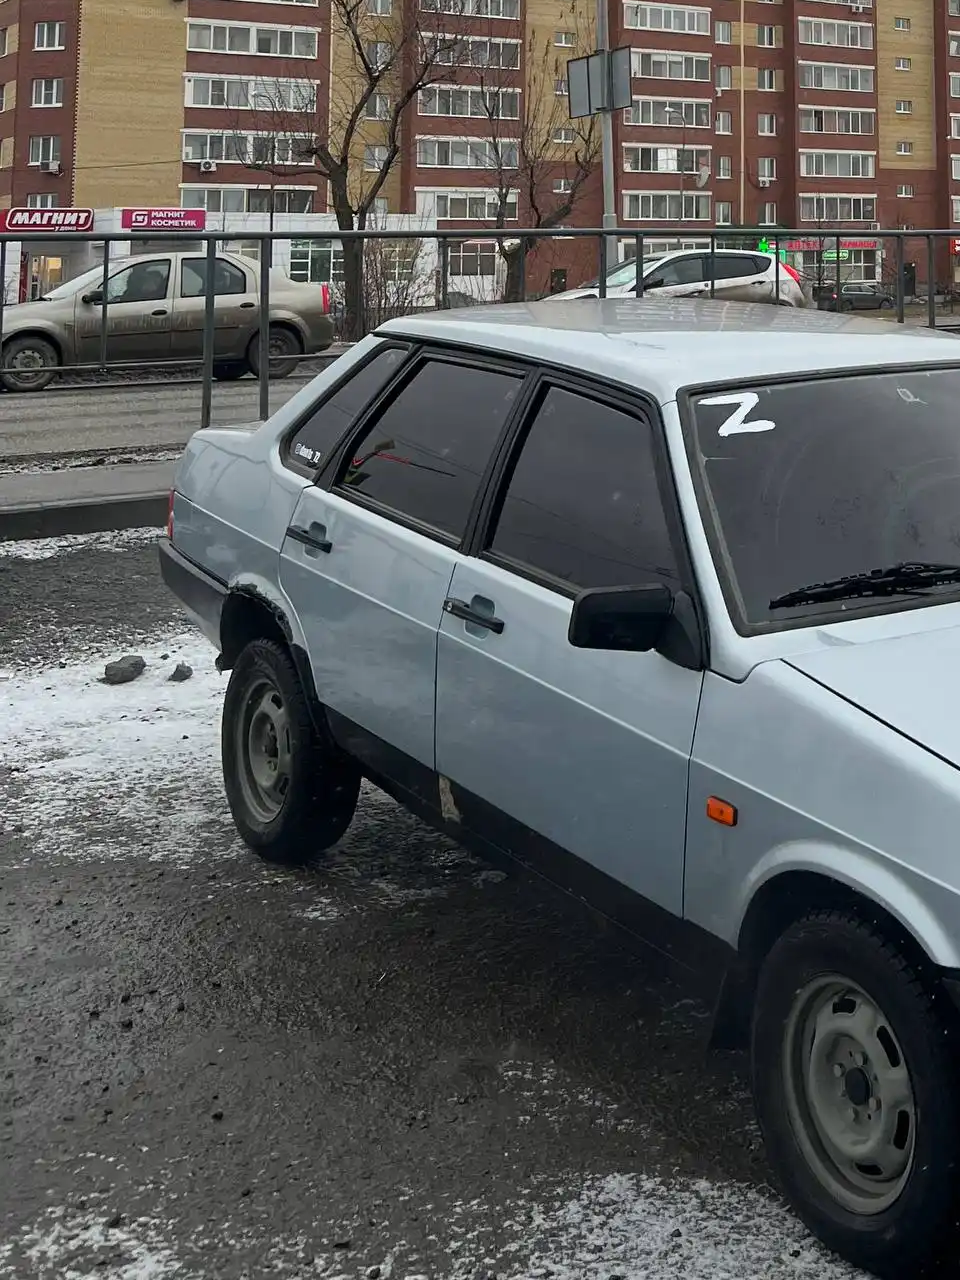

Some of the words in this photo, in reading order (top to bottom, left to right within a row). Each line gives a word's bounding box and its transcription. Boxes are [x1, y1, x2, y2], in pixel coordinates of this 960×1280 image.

[11, 212, 89, 225] МАГНИТ
[151, 219, 197, 227] КОСМЕТИК
[698, 392, 776, 437] Z
